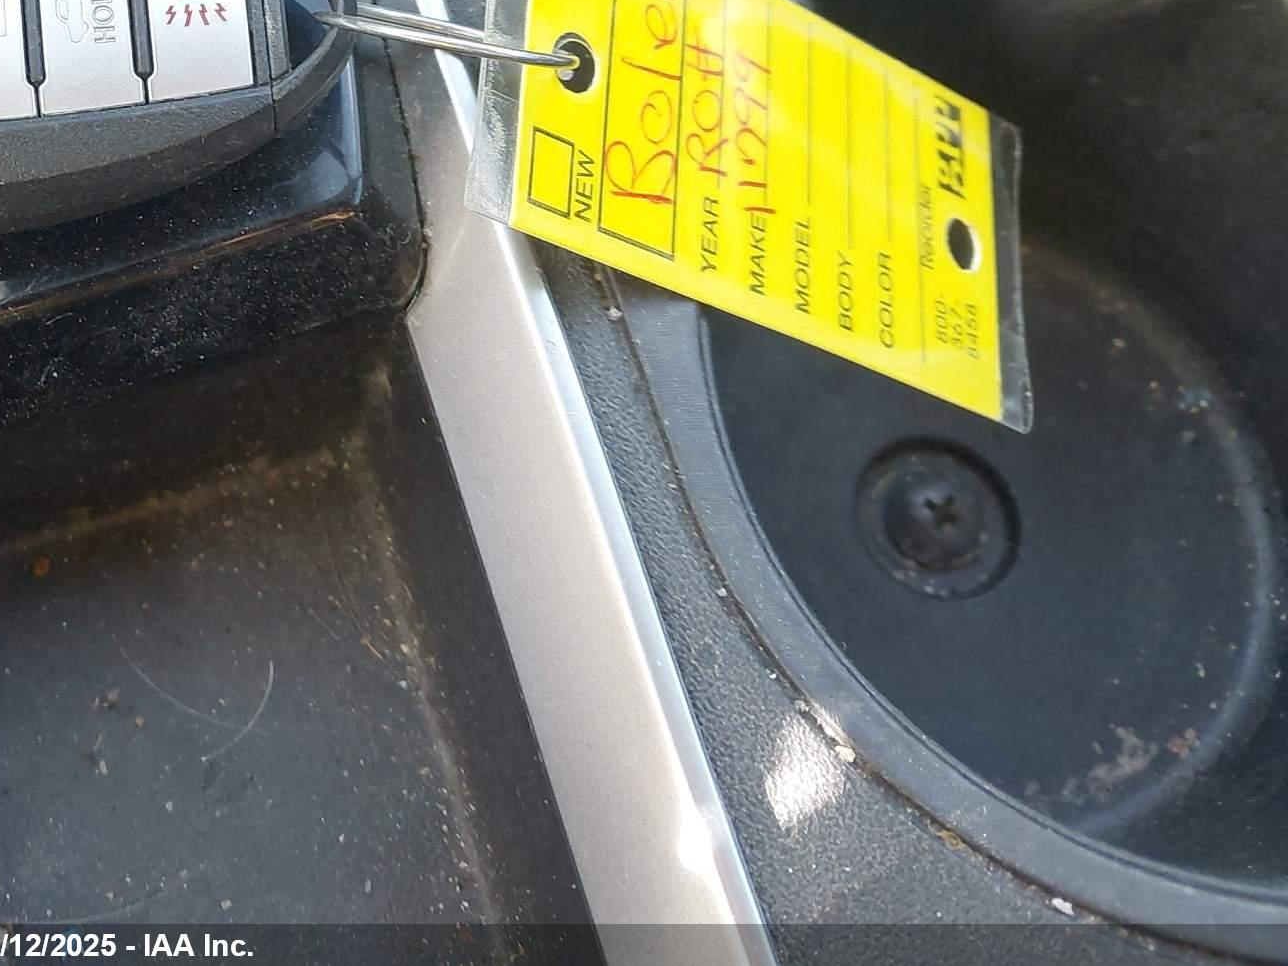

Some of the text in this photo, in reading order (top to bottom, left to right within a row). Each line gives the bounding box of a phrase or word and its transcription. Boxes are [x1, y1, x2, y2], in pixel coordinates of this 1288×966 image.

[572, 151, 597, 222] NEW
[699, 196, 720, 274] YEAR
[748, 215, 771, 296] MAKE
[794, 216, 812, 313] MODEL
[836, 251, 856, 332] BODY
[877, 252, 895, 349] COLOR
